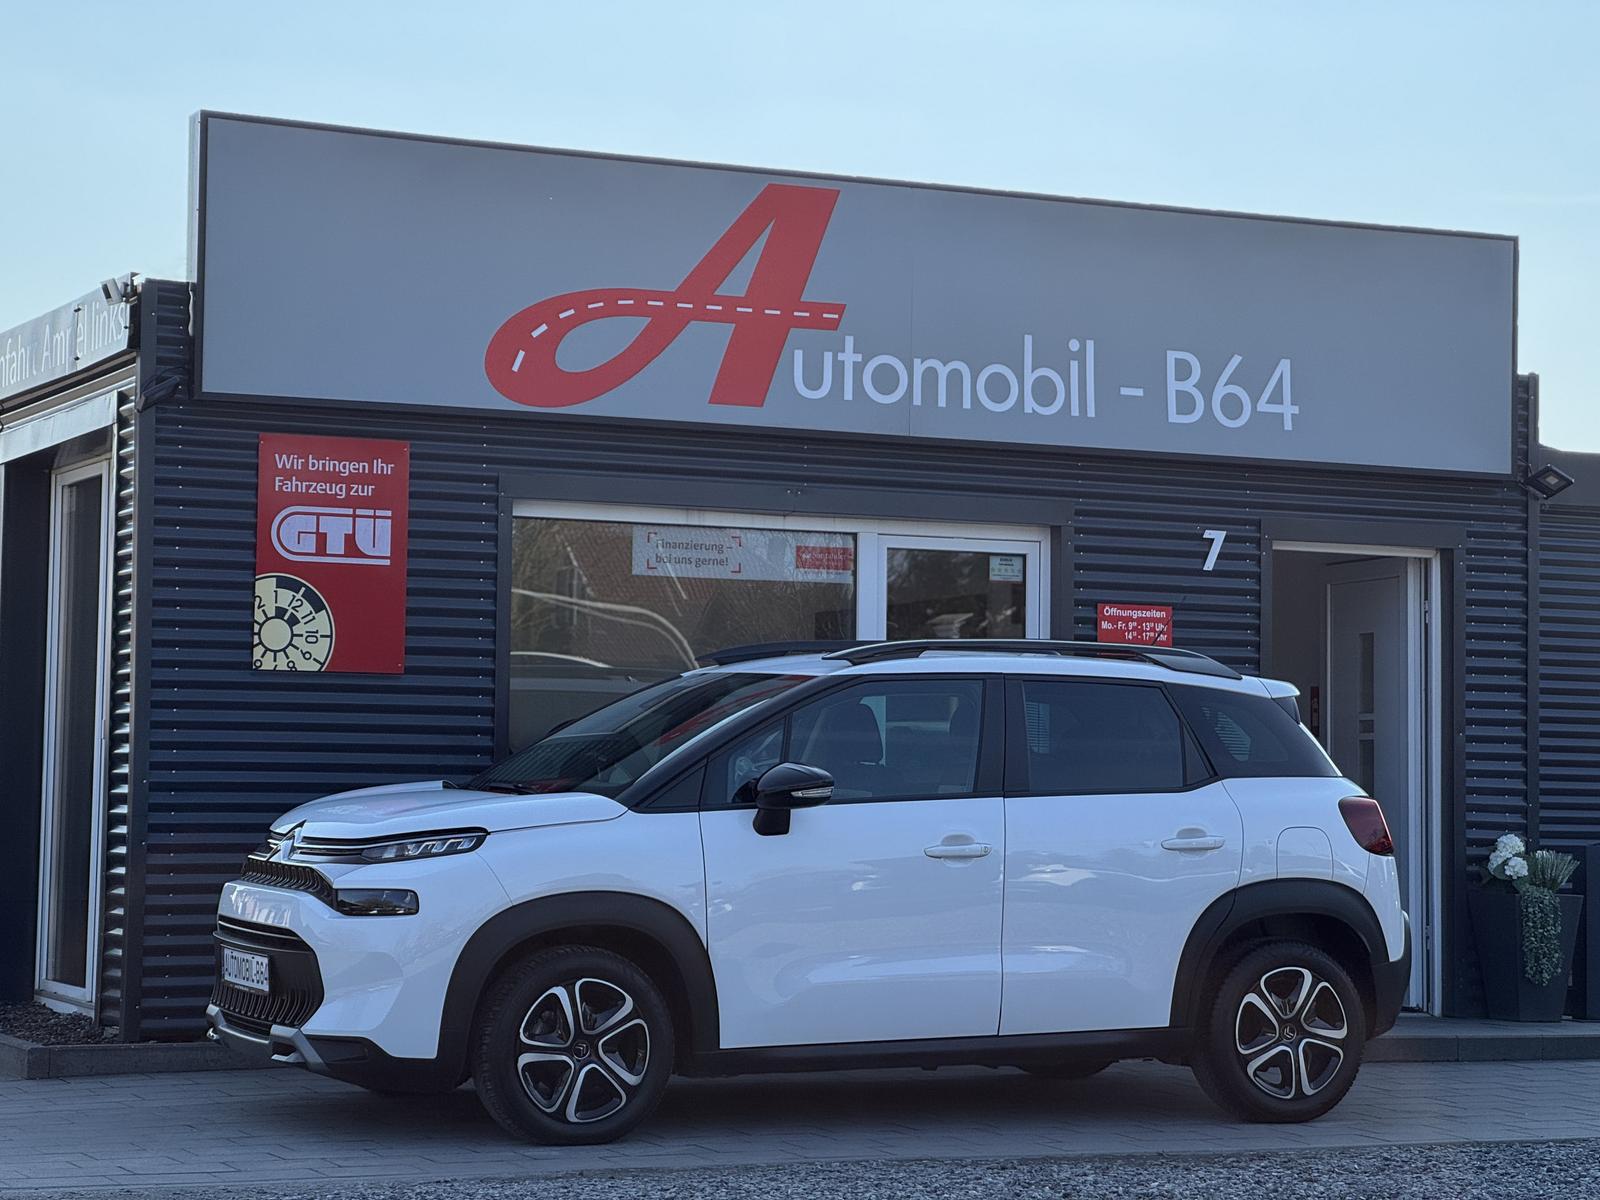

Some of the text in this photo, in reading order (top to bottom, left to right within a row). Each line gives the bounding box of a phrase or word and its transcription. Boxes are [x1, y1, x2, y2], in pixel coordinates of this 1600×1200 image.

[484, 183, 1299, 431] Automobil - B64
[274, 453, 395, 476] Wir bringen Ihr
[275, 476, 375, 498] Fahrzeug zur
[280, 508, 392, 557] GTÜ
[656, 539, 724, 554] Finanzierung
[1203, 530, 1226, 571] 7
[674, 556, 693, 565] uns
[695, 557, 729, 567] gerne!
[1103, 606, 1166, 619] Öffnungszeiten
